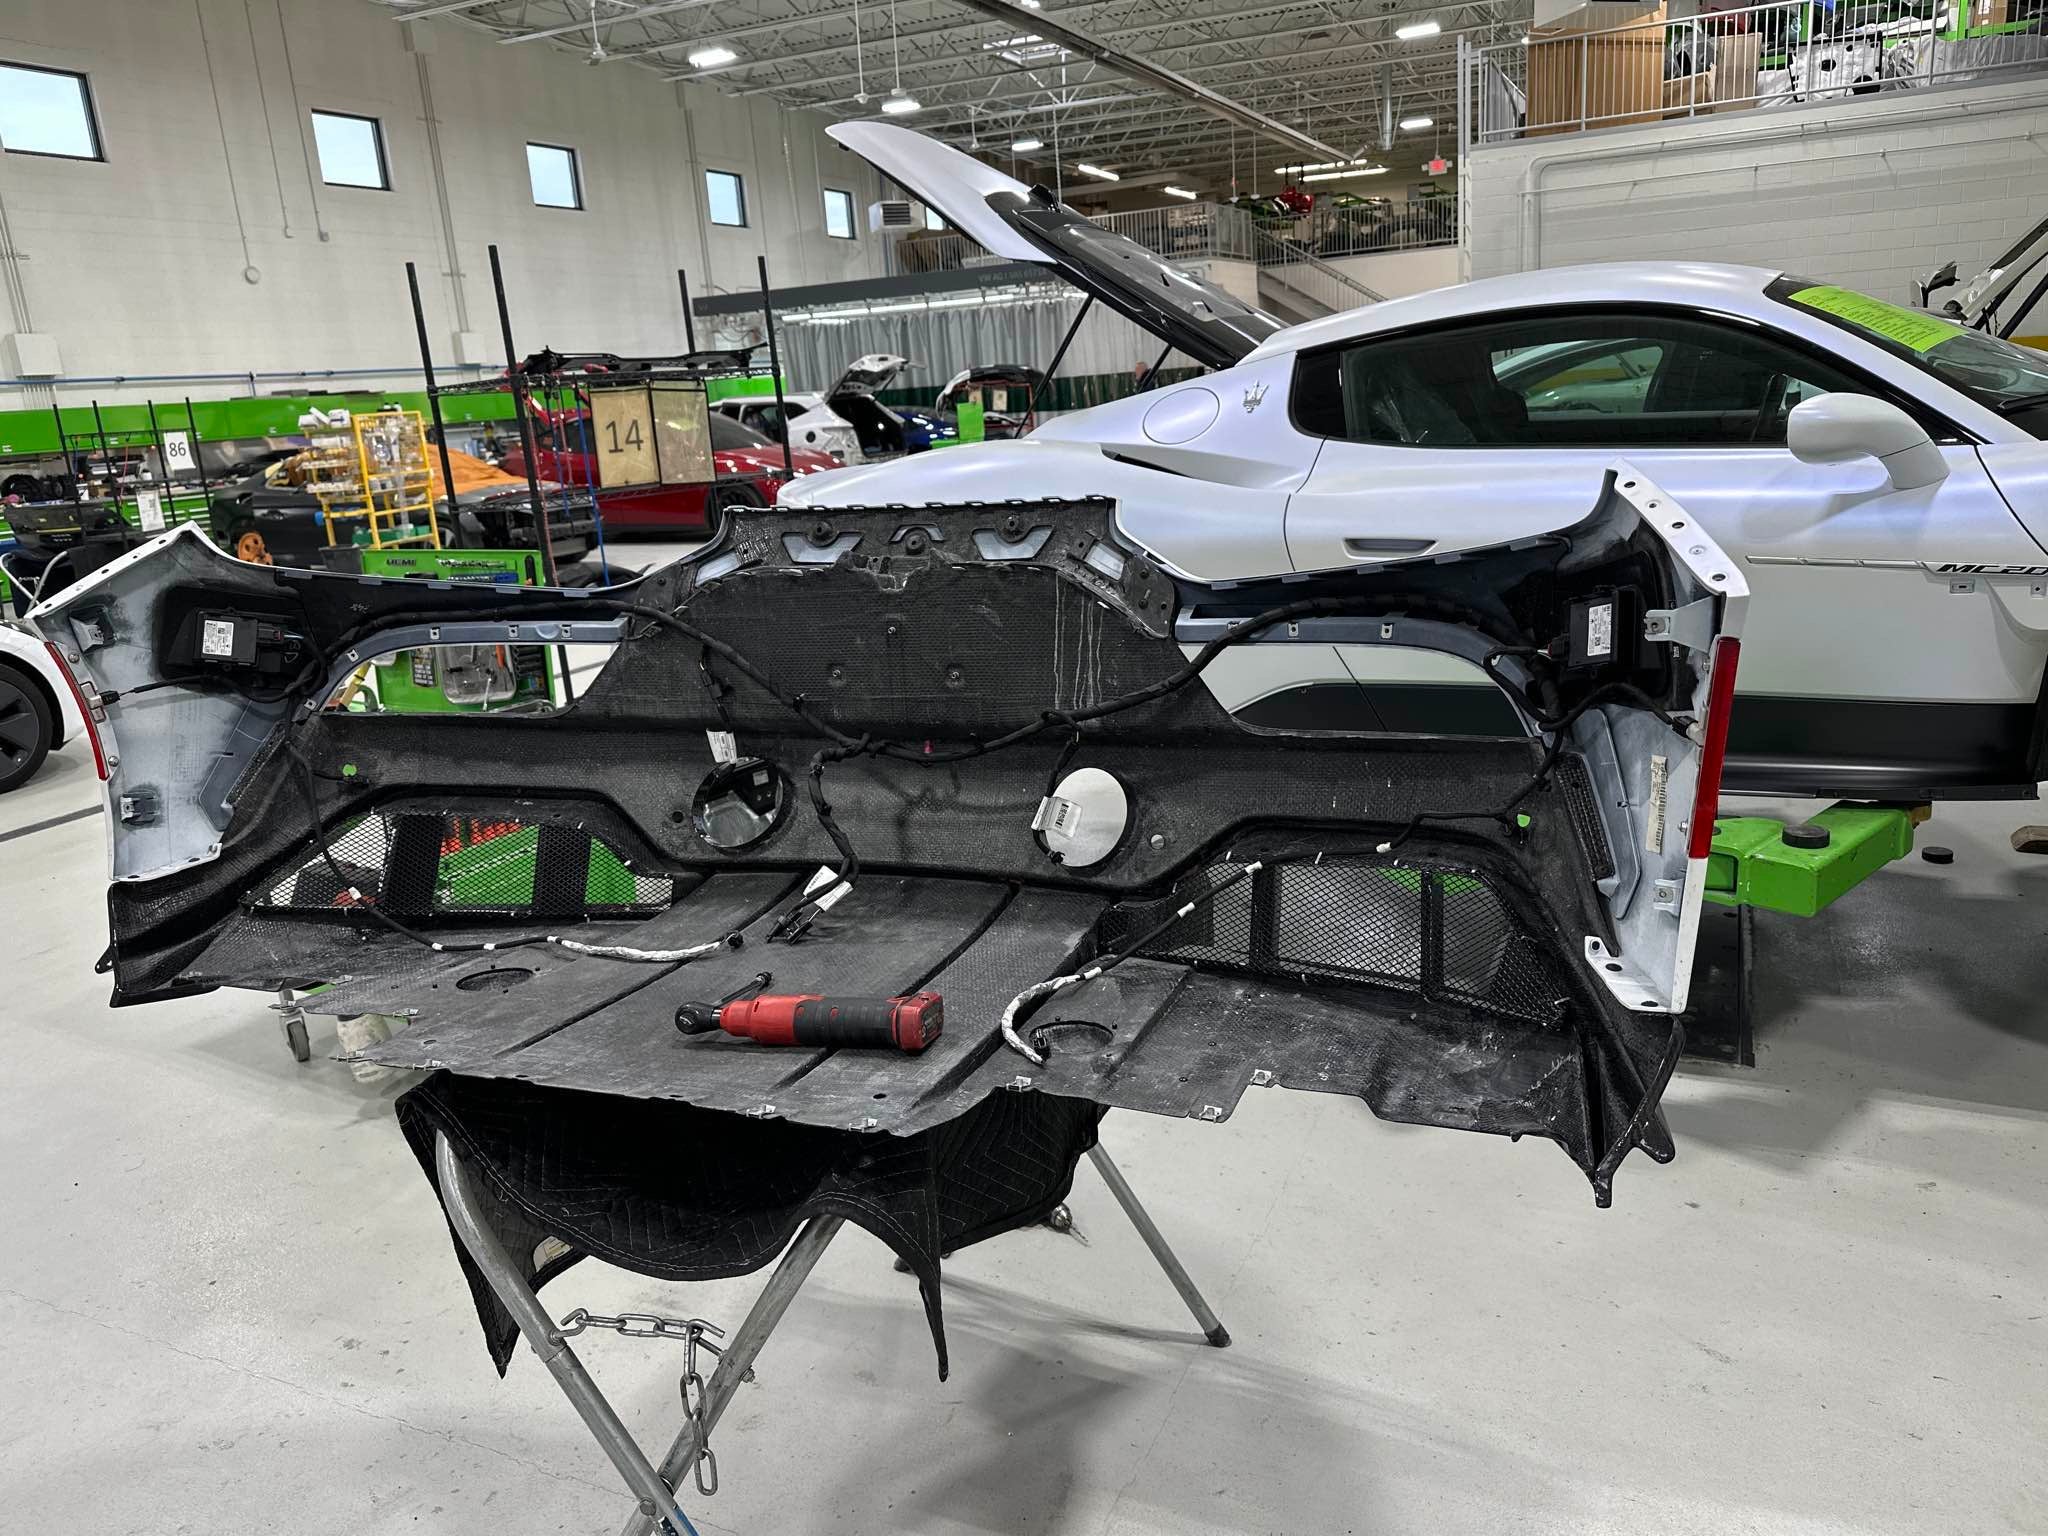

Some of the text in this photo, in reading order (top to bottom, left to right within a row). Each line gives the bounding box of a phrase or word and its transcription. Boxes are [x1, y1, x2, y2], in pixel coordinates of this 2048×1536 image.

[606, 420, 644, 453] 14
[169, 442, 186, 457] 86
[1936, 564, 2048, 575] MC20
